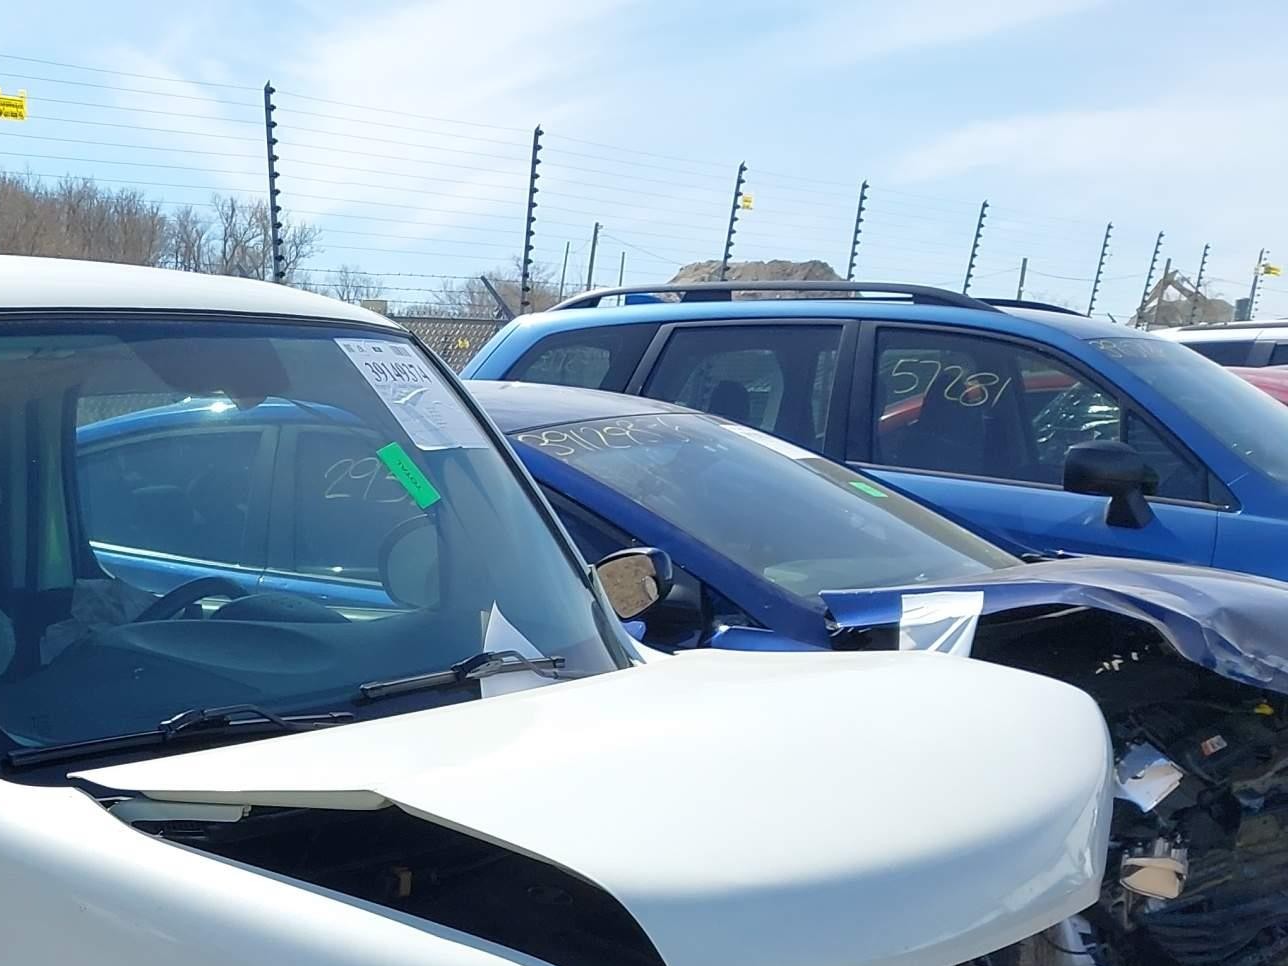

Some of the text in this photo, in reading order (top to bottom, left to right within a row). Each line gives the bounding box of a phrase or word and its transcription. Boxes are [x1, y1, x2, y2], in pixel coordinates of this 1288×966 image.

[364, 361, 433, 384] 39149374
[892, 359, 1012, 407] 57281
[397, 459, 422, 491] TOTAL
